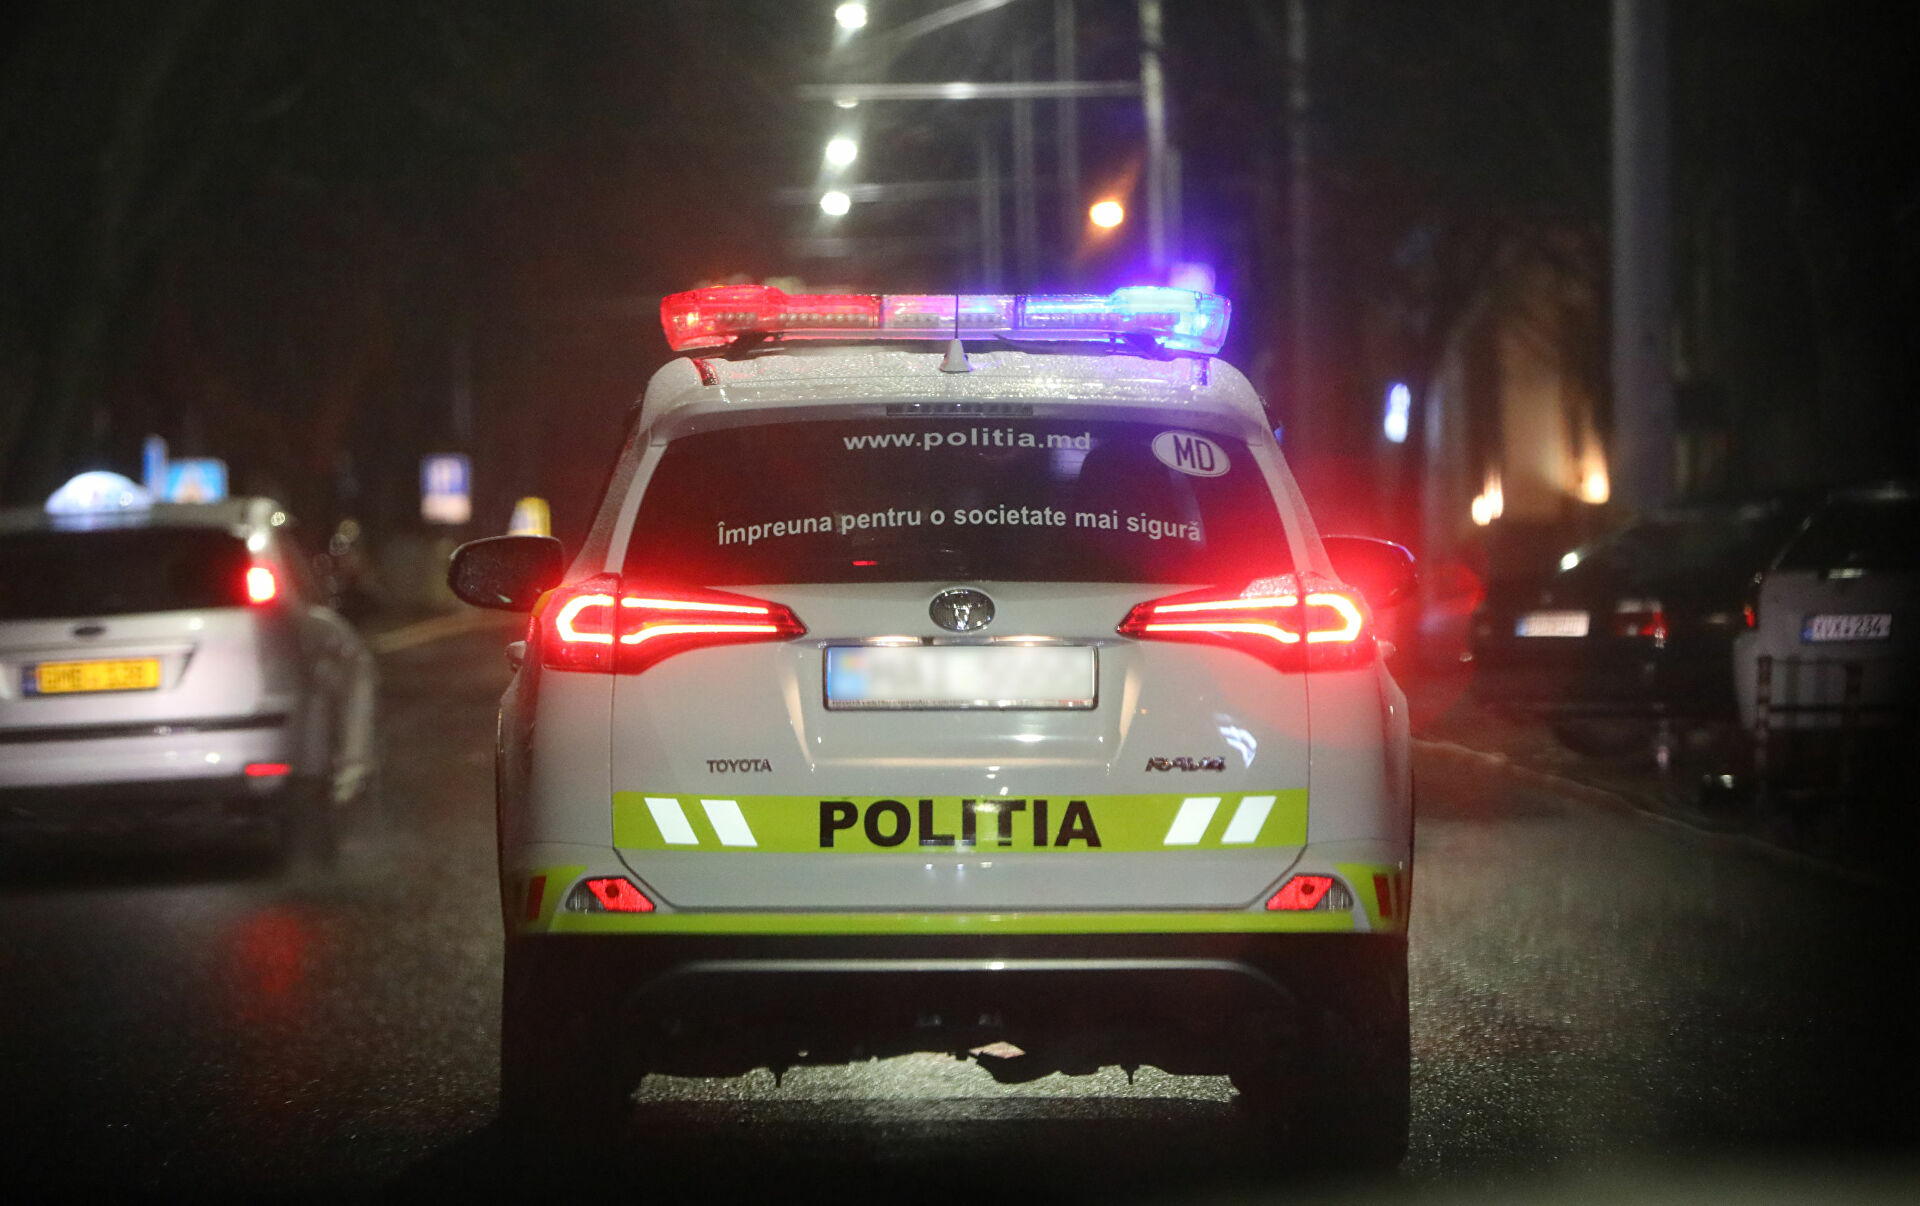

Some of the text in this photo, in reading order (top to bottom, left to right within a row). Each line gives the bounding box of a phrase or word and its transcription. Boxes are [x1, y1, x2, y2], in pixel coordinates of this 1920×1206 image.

[843, 428, 1091, 452] www.politia.md
[1172, 434, 1216, 474] MD
[717, 503, 1201, 546] Împreuna pentru o societate mai sigură
[706, 758, 773, 774] TOYOTA
[819, 799, 1102, 848] POLITIA
